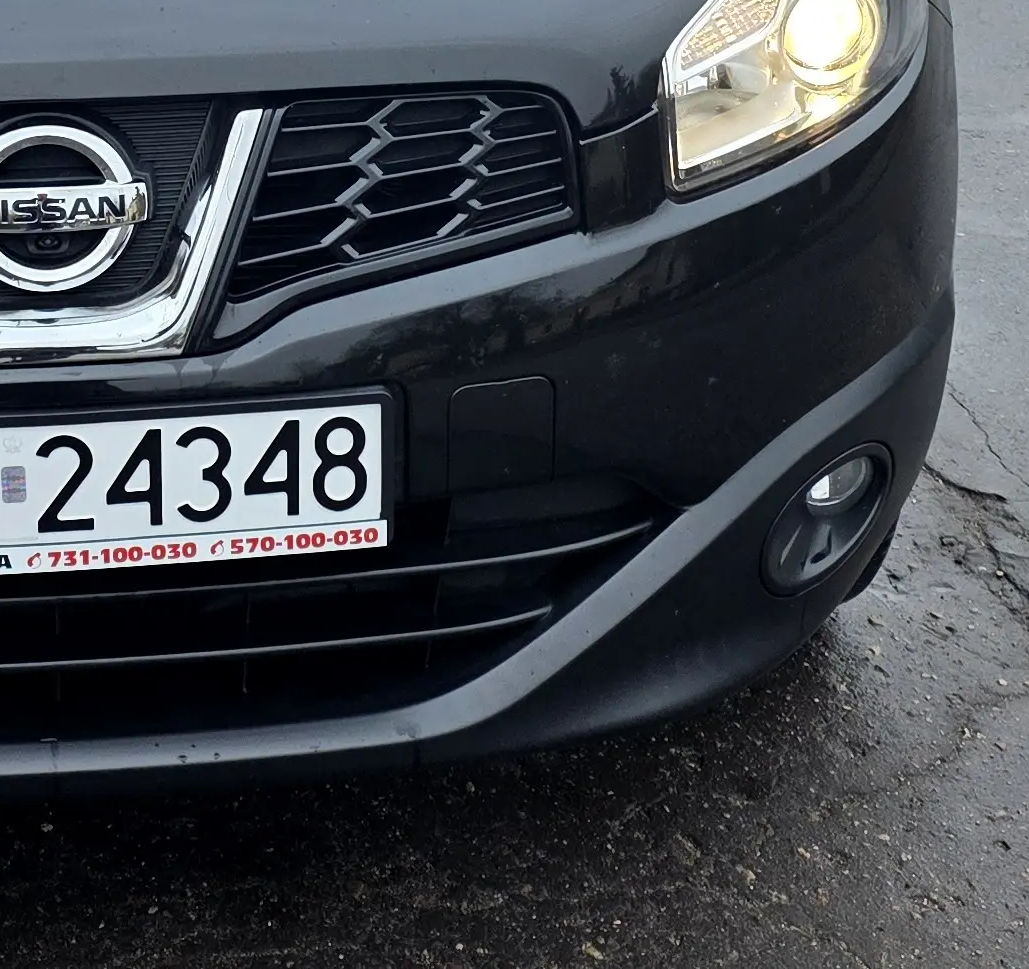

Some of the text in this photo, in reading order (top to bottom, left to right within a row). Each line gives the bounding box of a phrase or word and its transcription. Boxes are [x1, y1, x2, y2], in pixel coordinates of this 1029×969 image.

[35, 416, 368, 534] 24348
[47, 542, 197, 568] 731-100-030
[230, 527, 379, 555] 570-100-030
